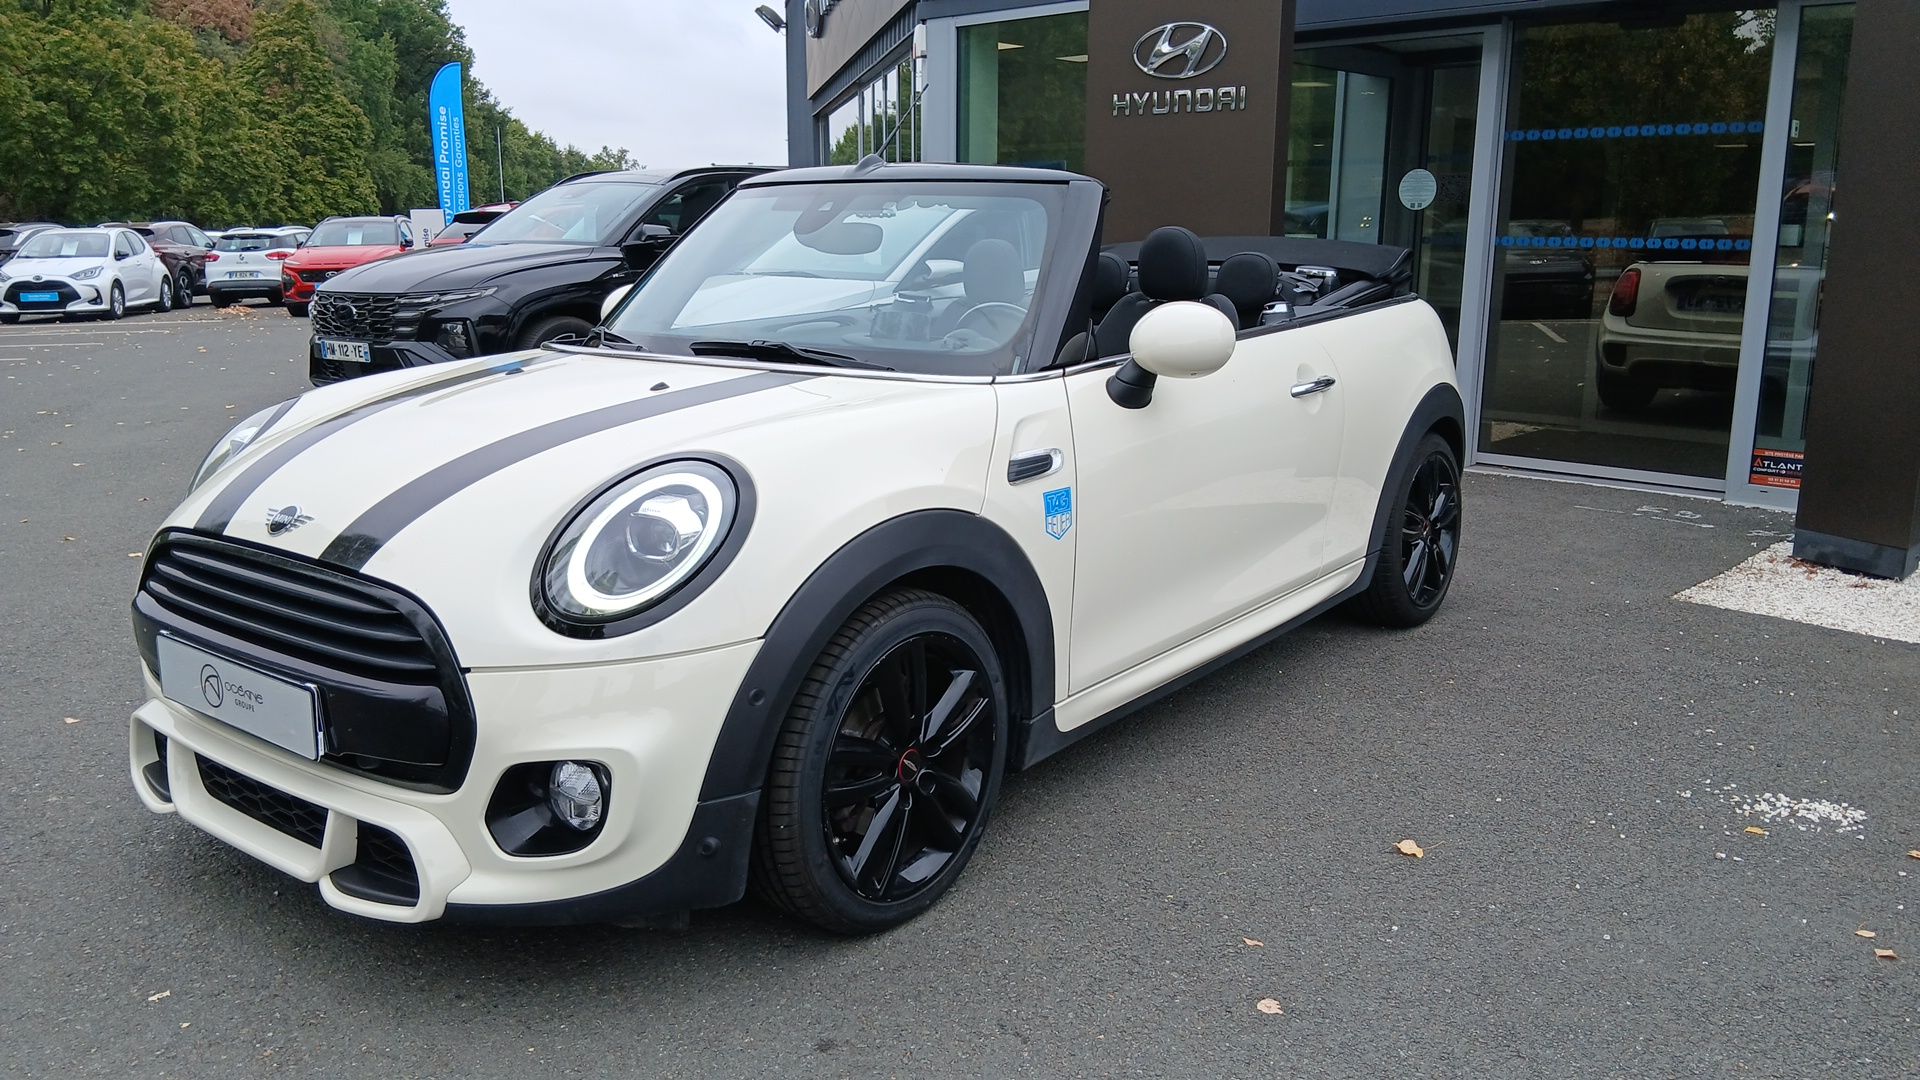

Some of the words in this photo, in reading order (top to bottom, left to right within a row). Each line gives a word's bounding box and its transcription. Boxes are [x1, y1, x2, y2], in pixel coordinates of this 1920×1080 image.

[1112, 85, 1246, 117] HYUNDAI
[437, 105, 450, 164] Promise
[453, 116, 464, 168] Garanties
[1753, 457, 1803, 471] ATLANT
